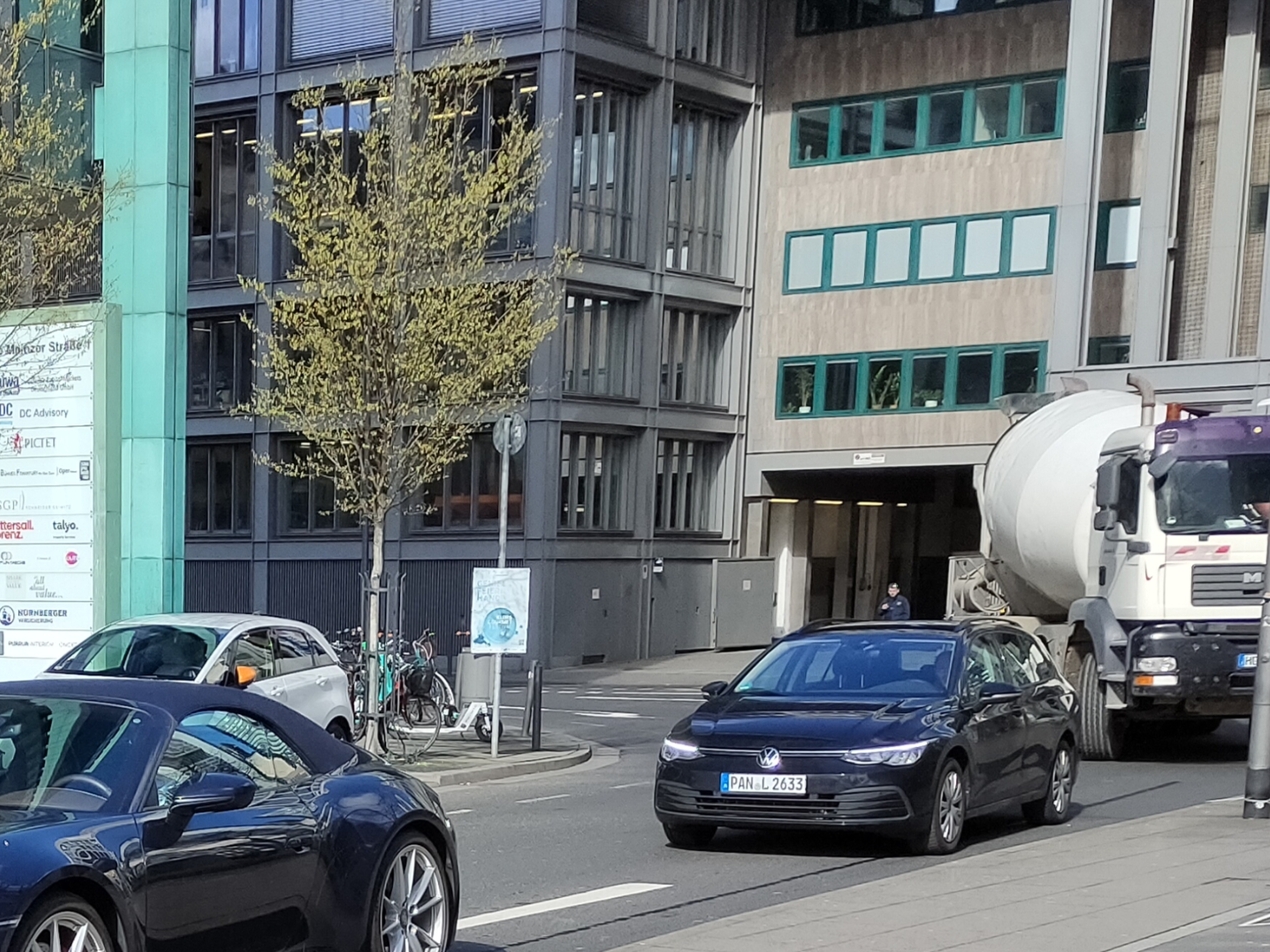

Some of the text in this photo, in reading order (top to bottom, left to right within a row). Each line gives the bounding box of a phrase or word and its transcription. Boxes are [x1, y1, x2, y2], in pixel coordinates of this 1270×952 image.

[48, 340, 82, 352] Straße
[19, 408, 32, 418] DC
[33, 407, 69, 419] Advisory
[24, 437, 56, 449] PICTET
[17, 609, 68, 617] NÜRNBERGER
[730, 776, 803, 791] PAN L 2633
